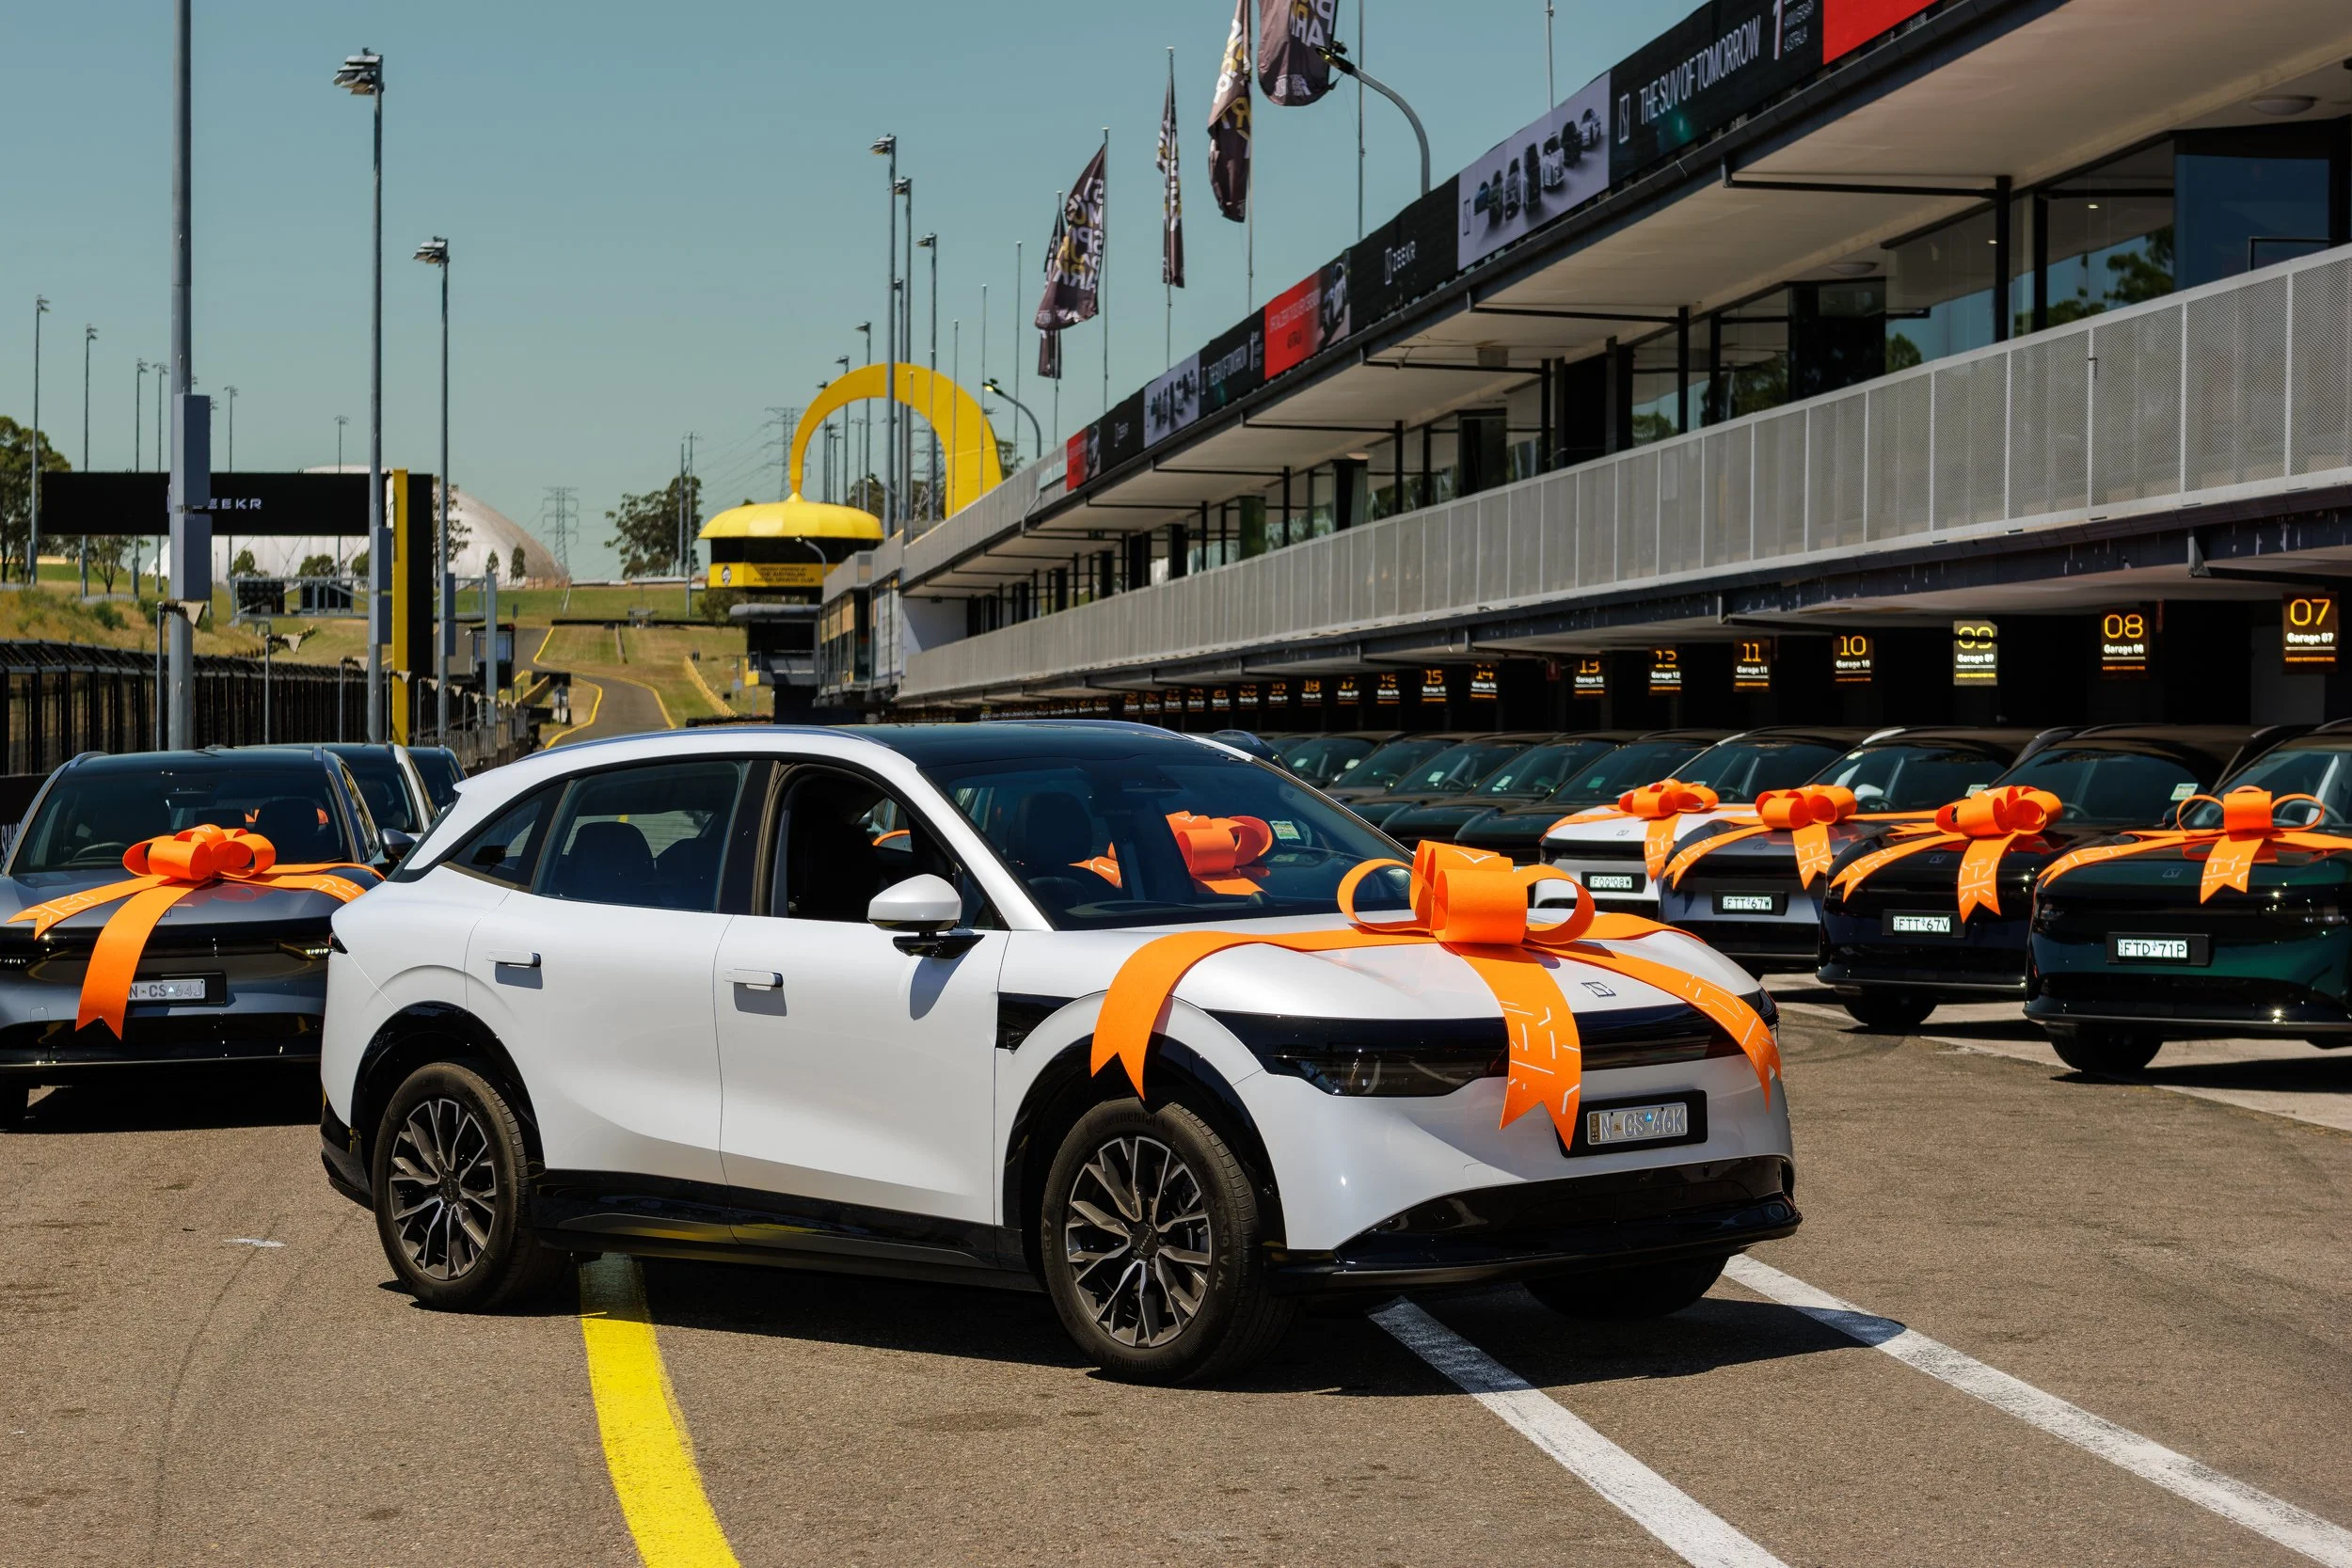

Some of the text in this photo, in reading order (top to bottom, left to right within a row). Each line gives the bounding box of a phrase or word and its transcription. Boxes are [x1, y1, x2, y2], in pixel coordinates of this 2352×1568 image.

[1640, 15, 1761, 126] THE SUV OF TOMORROW
[2290, 598, 2330, 626] 07
[2104, 614, 2143, 639] 08
[2286, 632, 2334, 644] Garage 07
[1742, 642, 1762, 662] 11
[1840, 636, 1867, 656] 10
[2104, 644, 2133, 656] Garage
[1836, 659, 1862, 670] Garage
[1957, 654, 1984, 664] Garage
[1737, 666, 1759, 674] Garage
[1425, 670, 1443, 685] 15
[1304, 680, 1320, 692] 18
